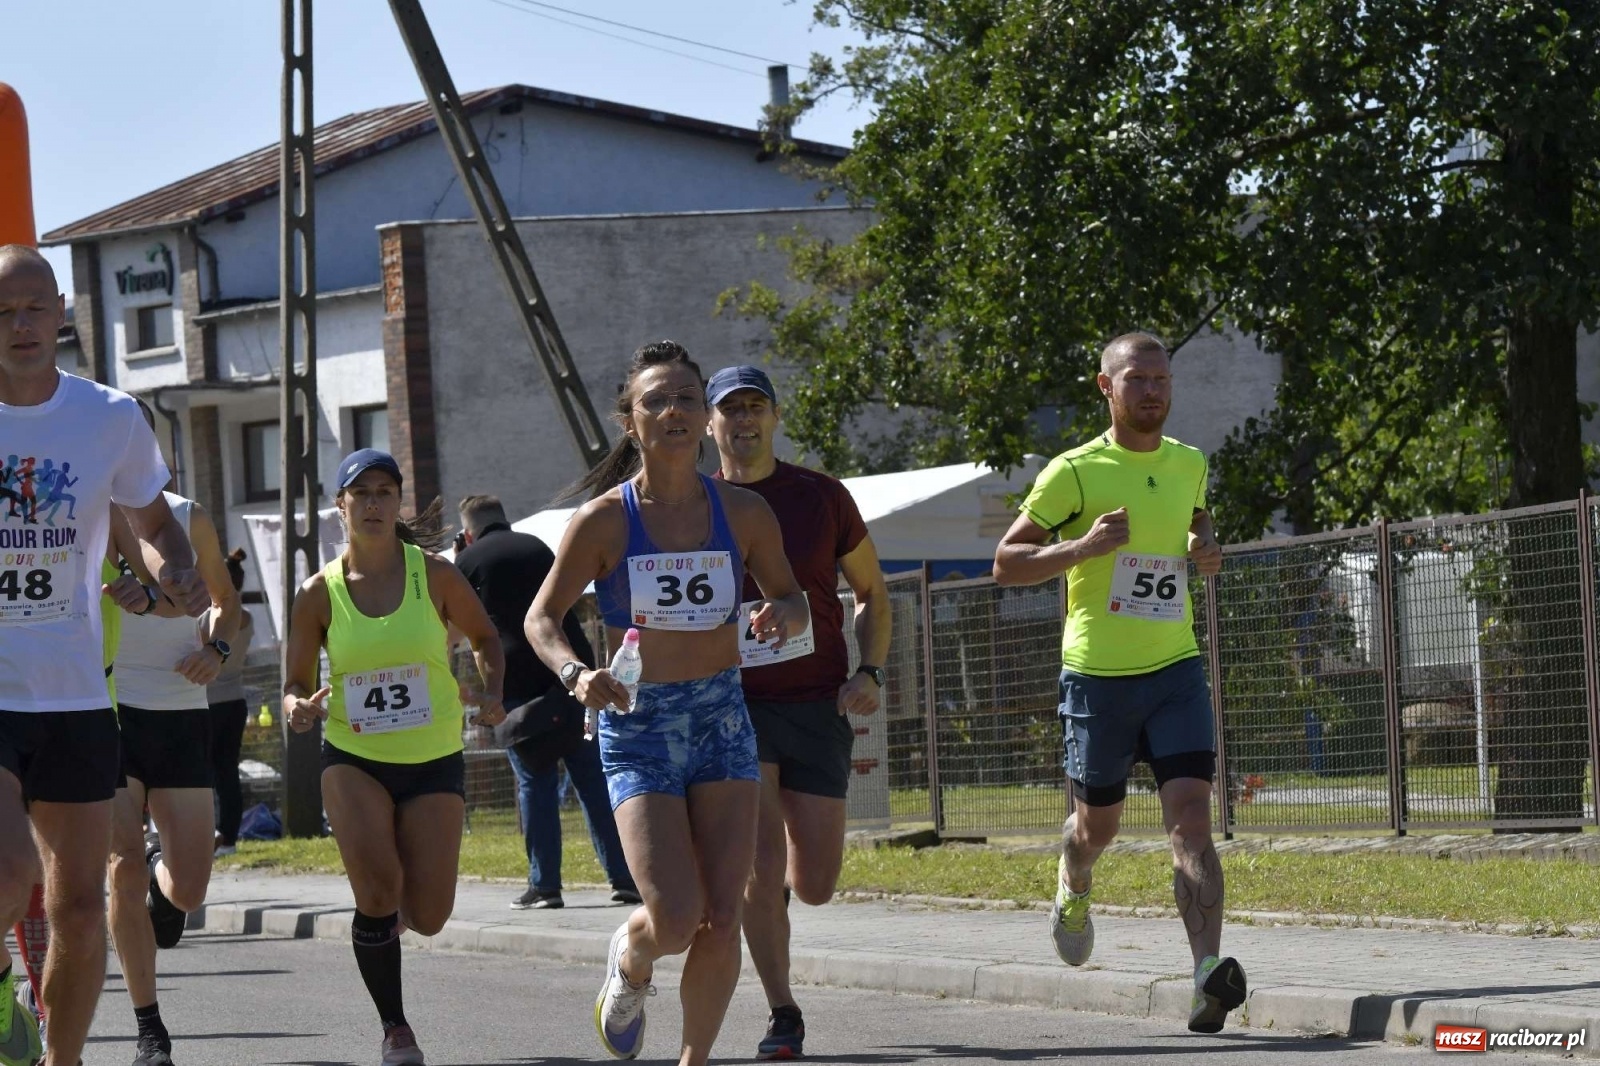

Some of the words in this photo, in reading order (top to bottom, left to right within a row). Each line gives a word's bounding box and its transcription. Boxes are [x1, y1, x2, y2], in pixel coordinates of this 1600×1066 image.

[43, 527, 76, 548] RUN
[0, 553, 35, 566] OUR
[42, 551, 68, 566] RUN
[637, 558, 694, 571] COLOUR
[701, 557, 724, 570] RUN
[1122, 557, 1168, 571] COLOUR
[0, 569, 52, 601] 48
[656, 573, 714, 606] 36
[1131, 572, 1177, 600] 56
[349, 672, 394, 687] COLOUR
[400, 667, 421, 680] RUN
[364, 684, 411, 712] 43
